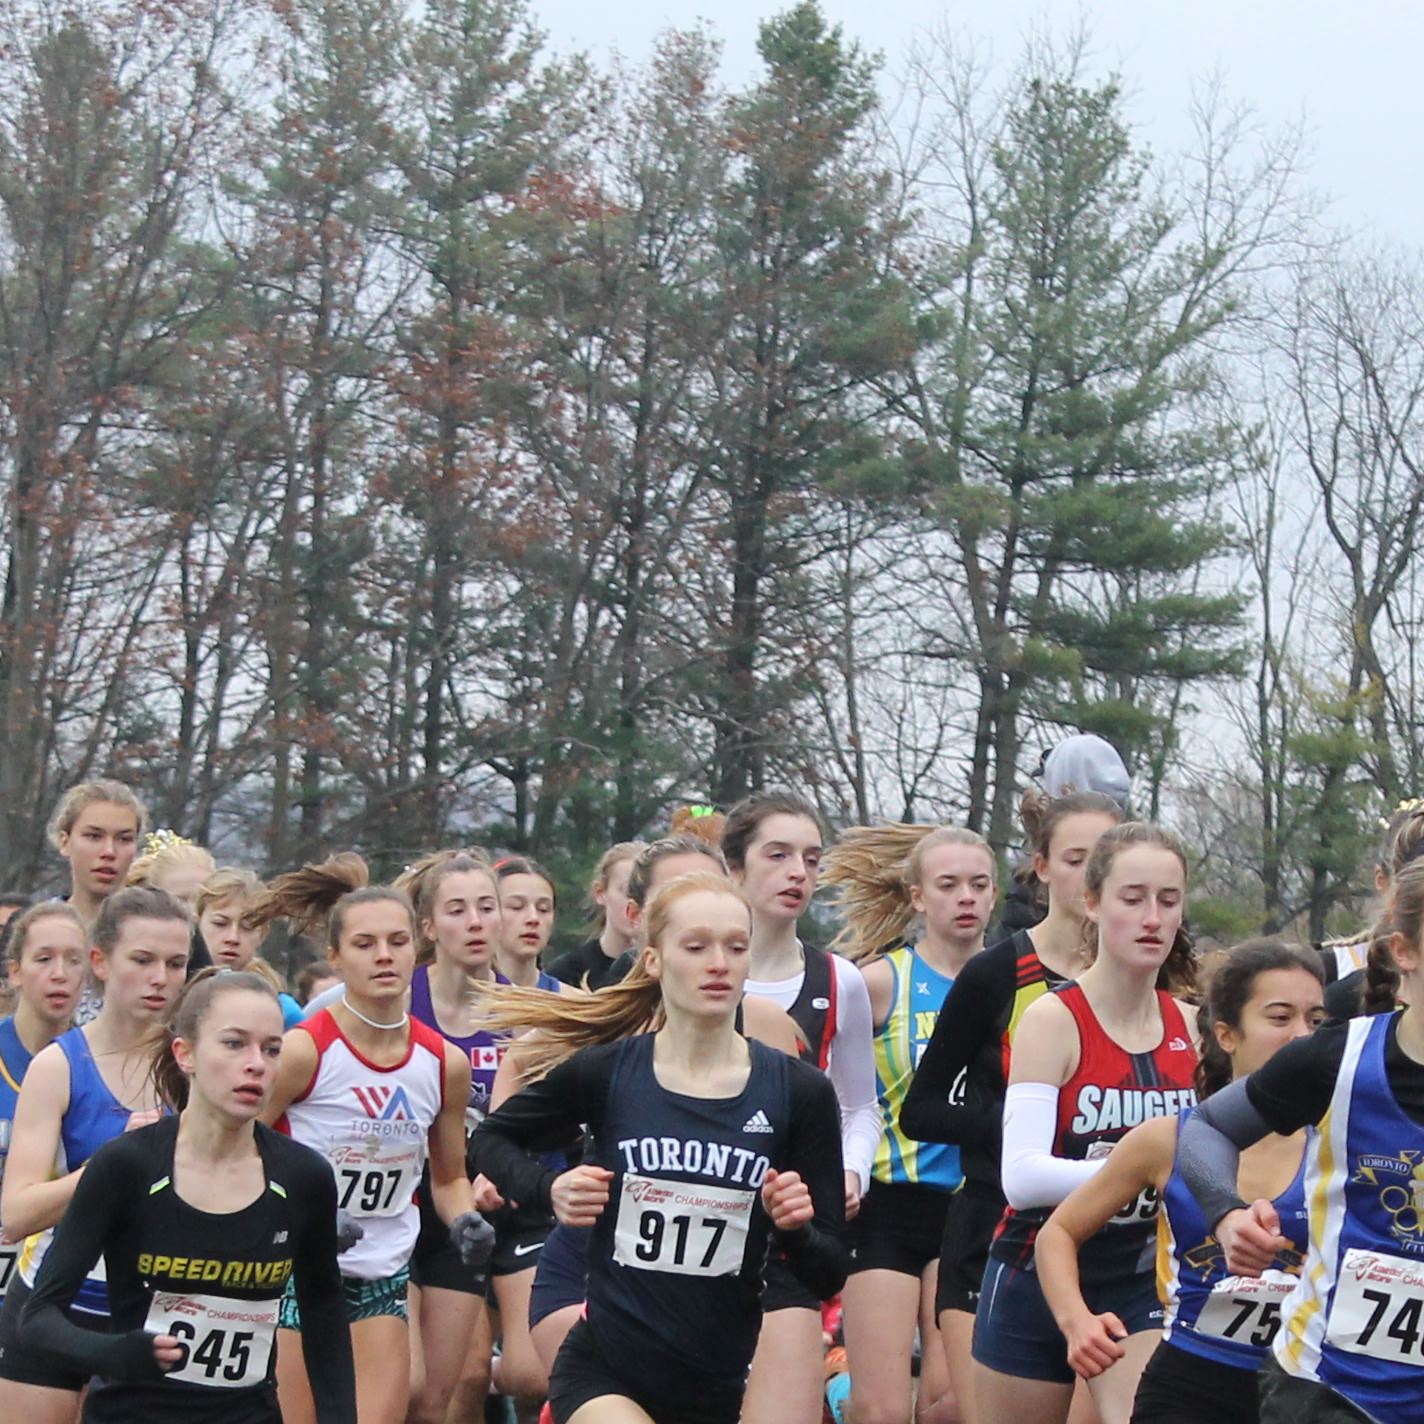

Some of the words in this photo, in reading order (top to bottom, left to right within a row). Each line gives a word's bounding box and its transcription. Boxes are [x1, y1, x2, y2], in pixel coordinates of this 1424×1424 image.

[351, 1119, 420, 1135] TORONTO
[742, 1124, 774, 1134] adidas
[1072, 1084, 1198, 1135] SAUGEE
[618, 1137, 770, 1189] TORONTO
[1362, 1158, 1408, 1174] TORONTO
[339, 1169, 402, 1212] 797
[675, 1194, 750, 1212] CHAMPIONSHIPS
[636, 1210, 728, 1268] 917
[207, 1309, 276, 1322] CHAMPIONSHIPS
[1222, 1298, 1282, 1347] 75
[168, 1320, 254, 1381] 645
